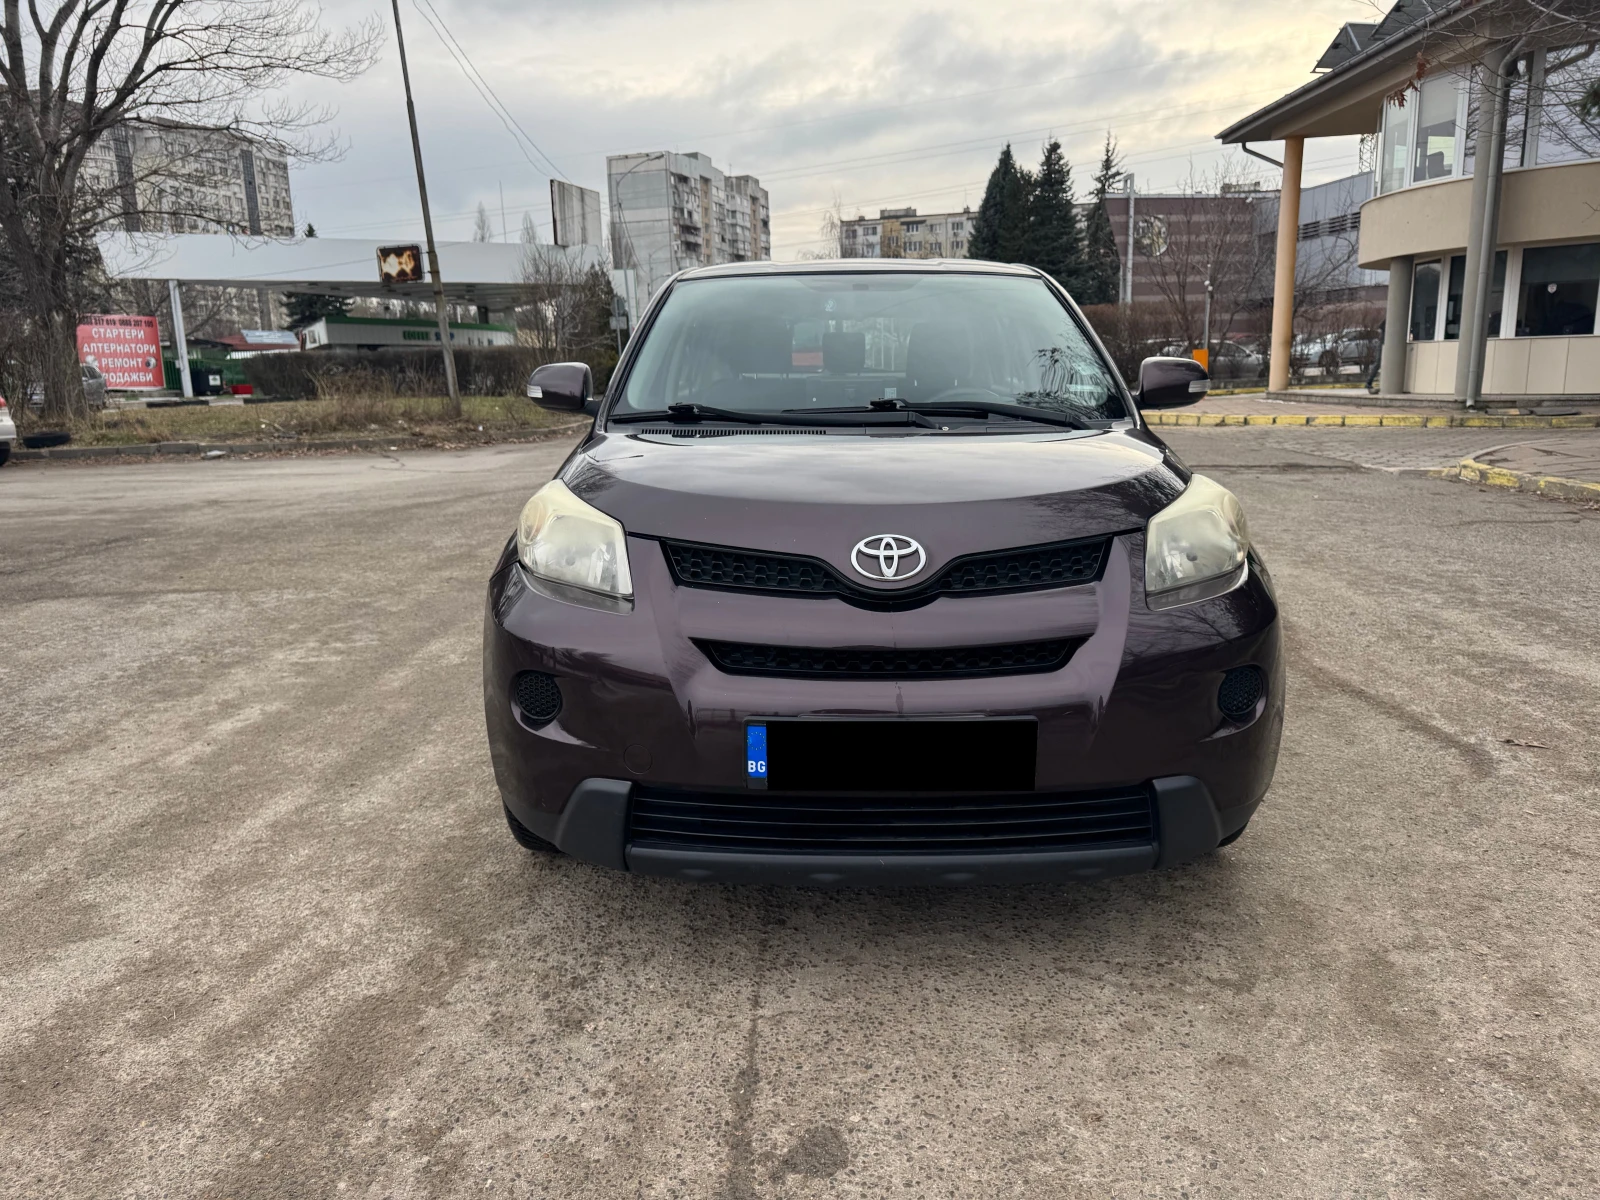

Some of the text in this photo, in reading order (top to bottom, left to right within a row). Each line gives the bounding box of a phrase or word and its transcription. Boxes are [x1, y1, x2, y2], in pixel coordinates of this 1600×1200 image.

[92, 328, 145, 339] СТАРТЕРИ
[102, 358, 142, 368] РЕМОНТ
[101, 372, 153, 384] РОДАЖБИ
[747, 760, 766, 773] BG
